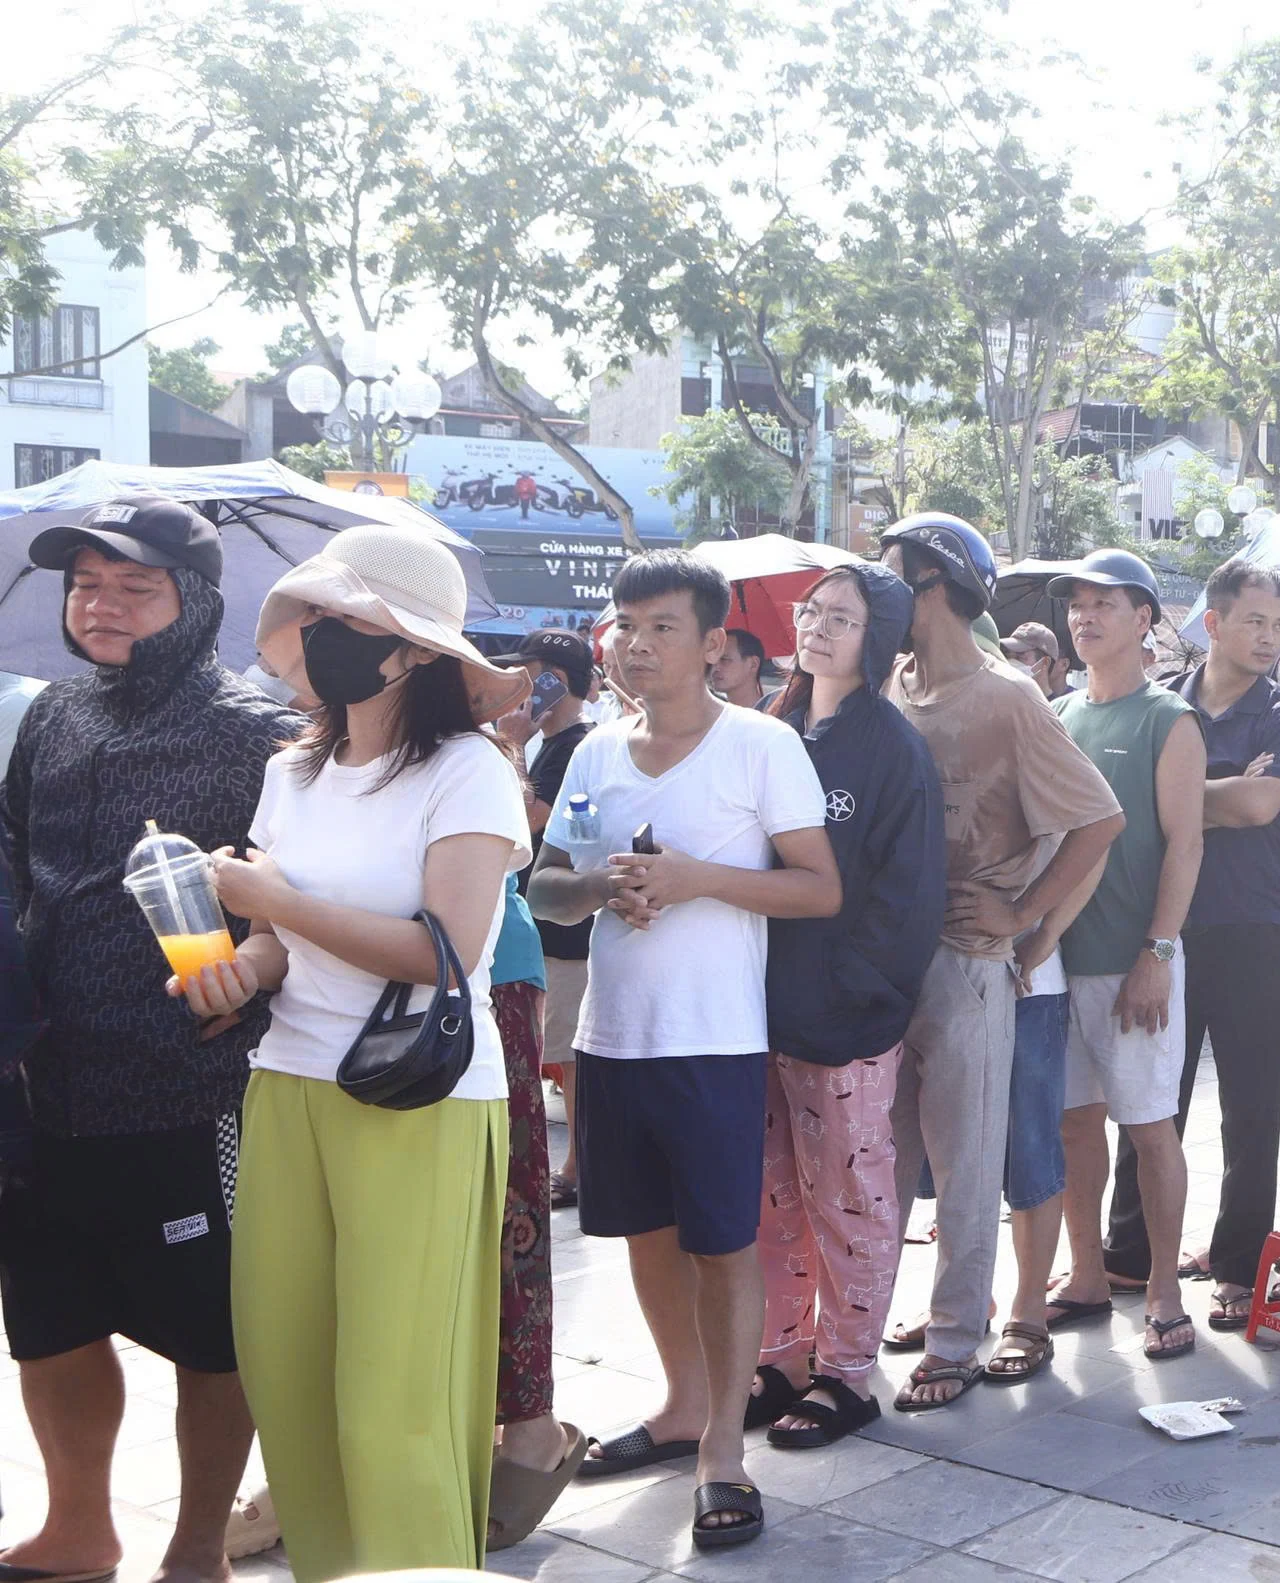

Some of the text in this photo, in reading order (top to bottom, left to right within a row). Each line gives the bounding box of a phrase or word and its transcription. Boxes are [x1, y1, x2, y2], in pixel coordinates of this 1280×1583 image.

[540, 541, 623, 557] CỬA HÀNG XE
[928, 533, 965, 569] Vespa
[545, 559, 617, 578] VINF
